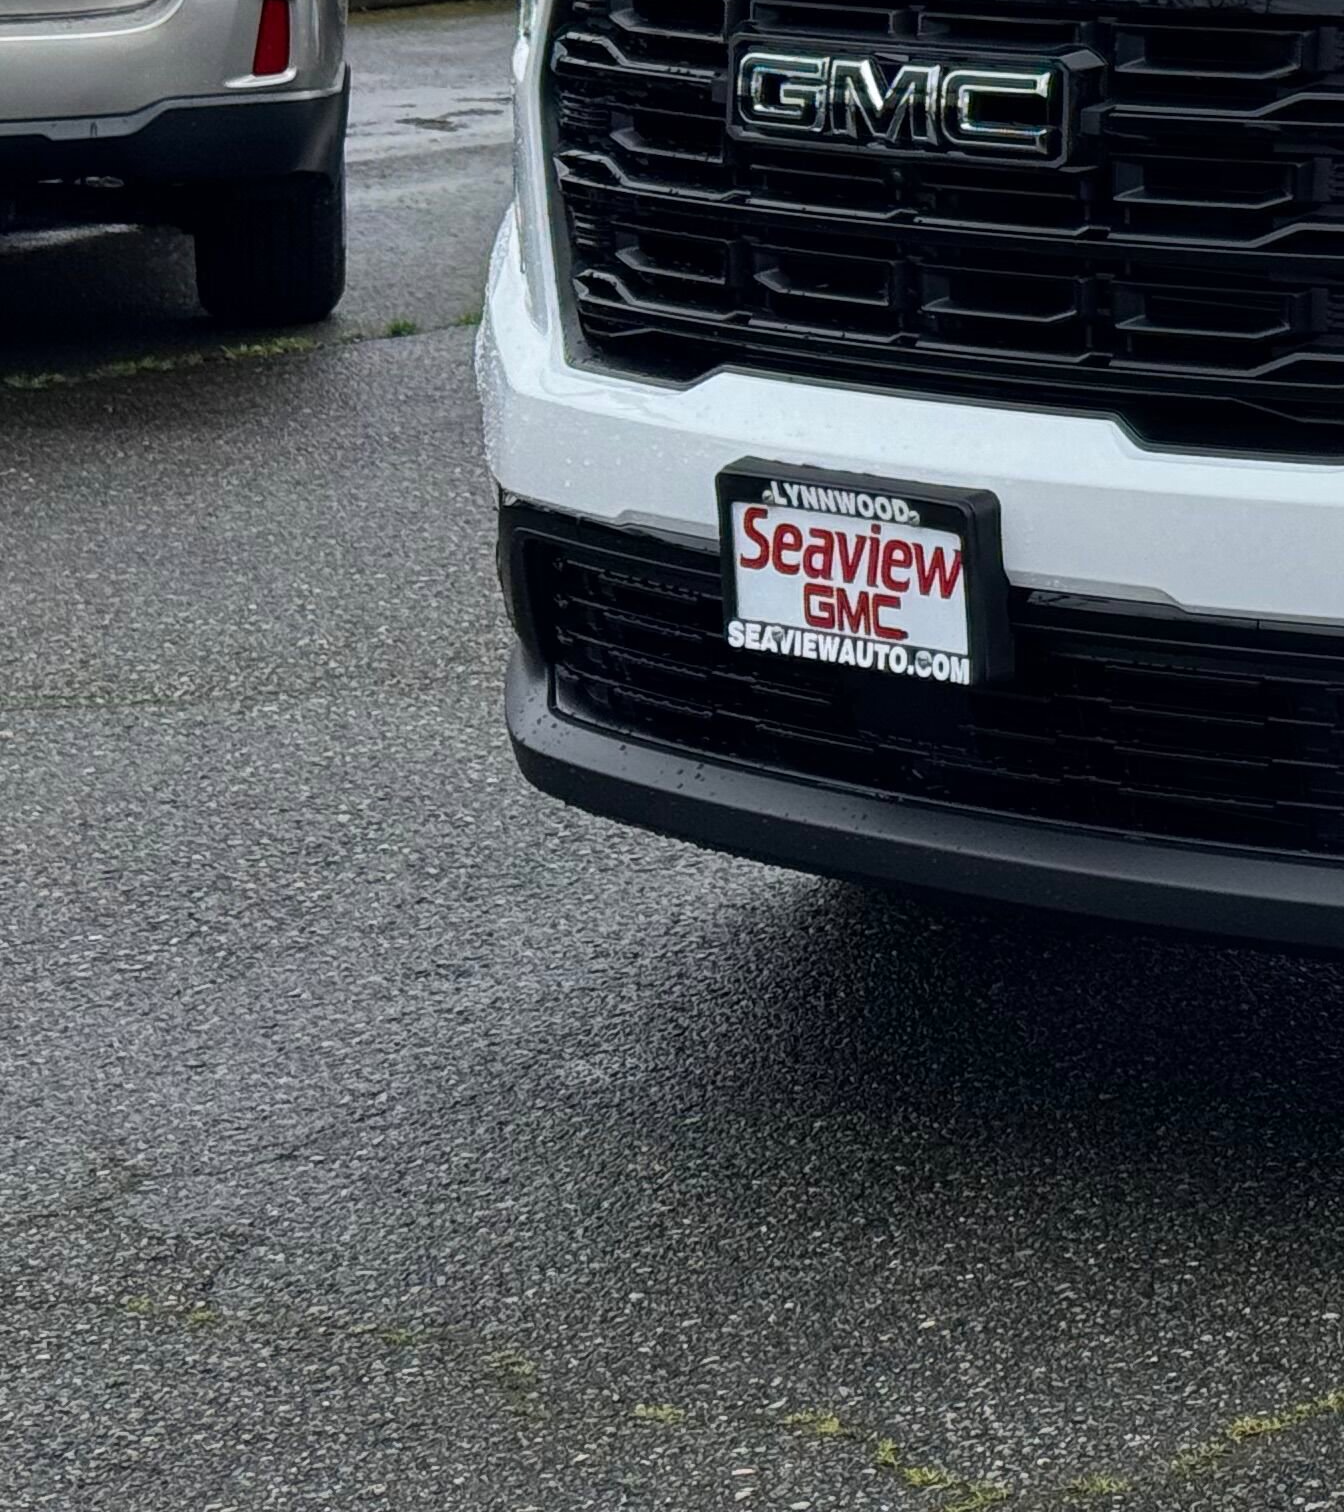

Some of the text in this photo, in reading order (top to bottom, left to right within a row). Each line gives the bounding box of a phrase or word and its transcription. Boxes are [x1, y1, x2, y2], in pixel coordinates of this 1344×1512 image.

[737, 52, 1052, 155] GMC
[770, 481, 910, 524] LYNNWOOD
[740, 506, 964, 600] Seaview
[803, 582, 909, 642] GMC
[727, 620, 971, 686] SEAVIEWAUTO.COM
